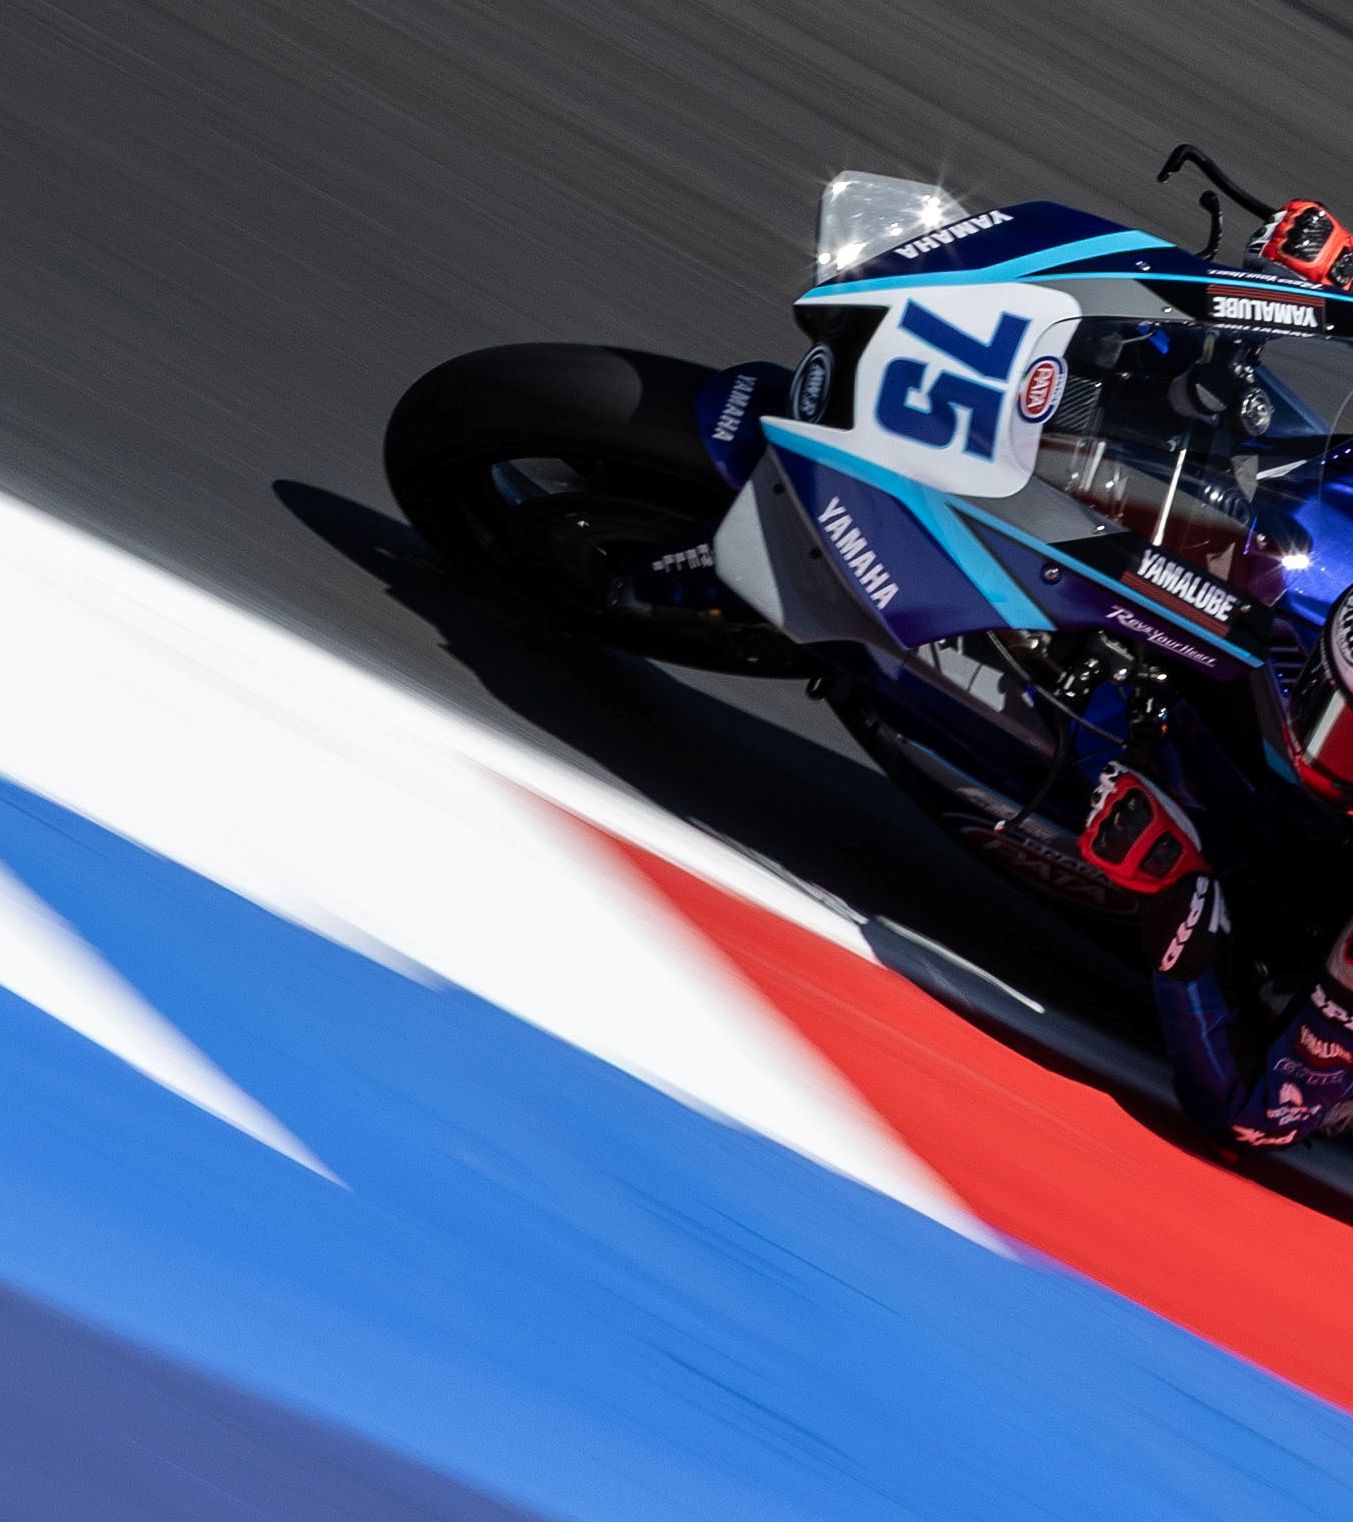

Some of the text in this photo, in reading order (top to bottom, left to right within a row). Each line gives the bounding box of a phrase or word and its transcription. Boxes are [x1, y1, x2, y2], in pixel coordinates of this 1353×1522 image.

[895, 210, 1014, 259] YAMAHA
[1213, 296, 1318, 328] YAMALUBE
[711, 374, 757, 442] YAMAHA
[876, 298, 1032, 462] 75
[1027, 365, 1057, 410] PATA
[817, 496, 900, 610] YAMAHA
[1136, 549, 1238, 622] YAMALUBE
